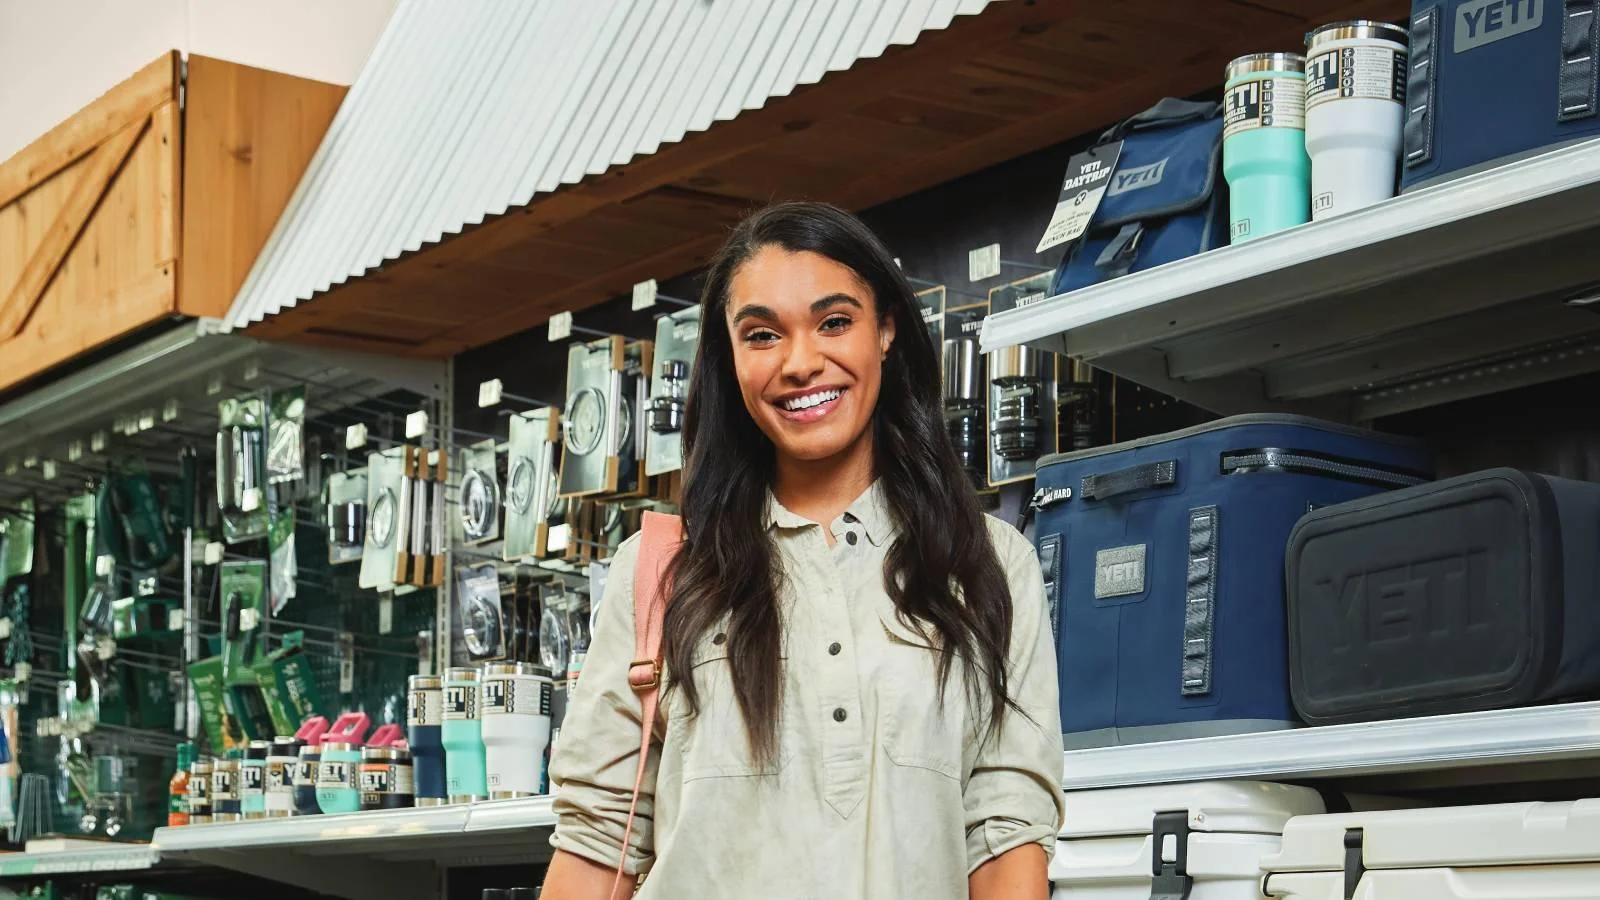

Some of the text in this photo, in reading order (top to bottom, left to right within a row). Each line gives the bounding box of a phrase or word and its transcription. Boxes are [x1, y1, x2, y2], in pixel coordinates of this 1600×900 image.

[1463, 0, 1535, 38] YETI
[1063, 166, 1111, 191] DAYTRIP
[1080, 160, 1102, 175] YETI
[1117, 166, 1161, 189] YETI
[1054, 487, 1072, 500] HARD
[1103, 562, 1138, 584] YETI
[1314, 546, 1489, 653] YETI
